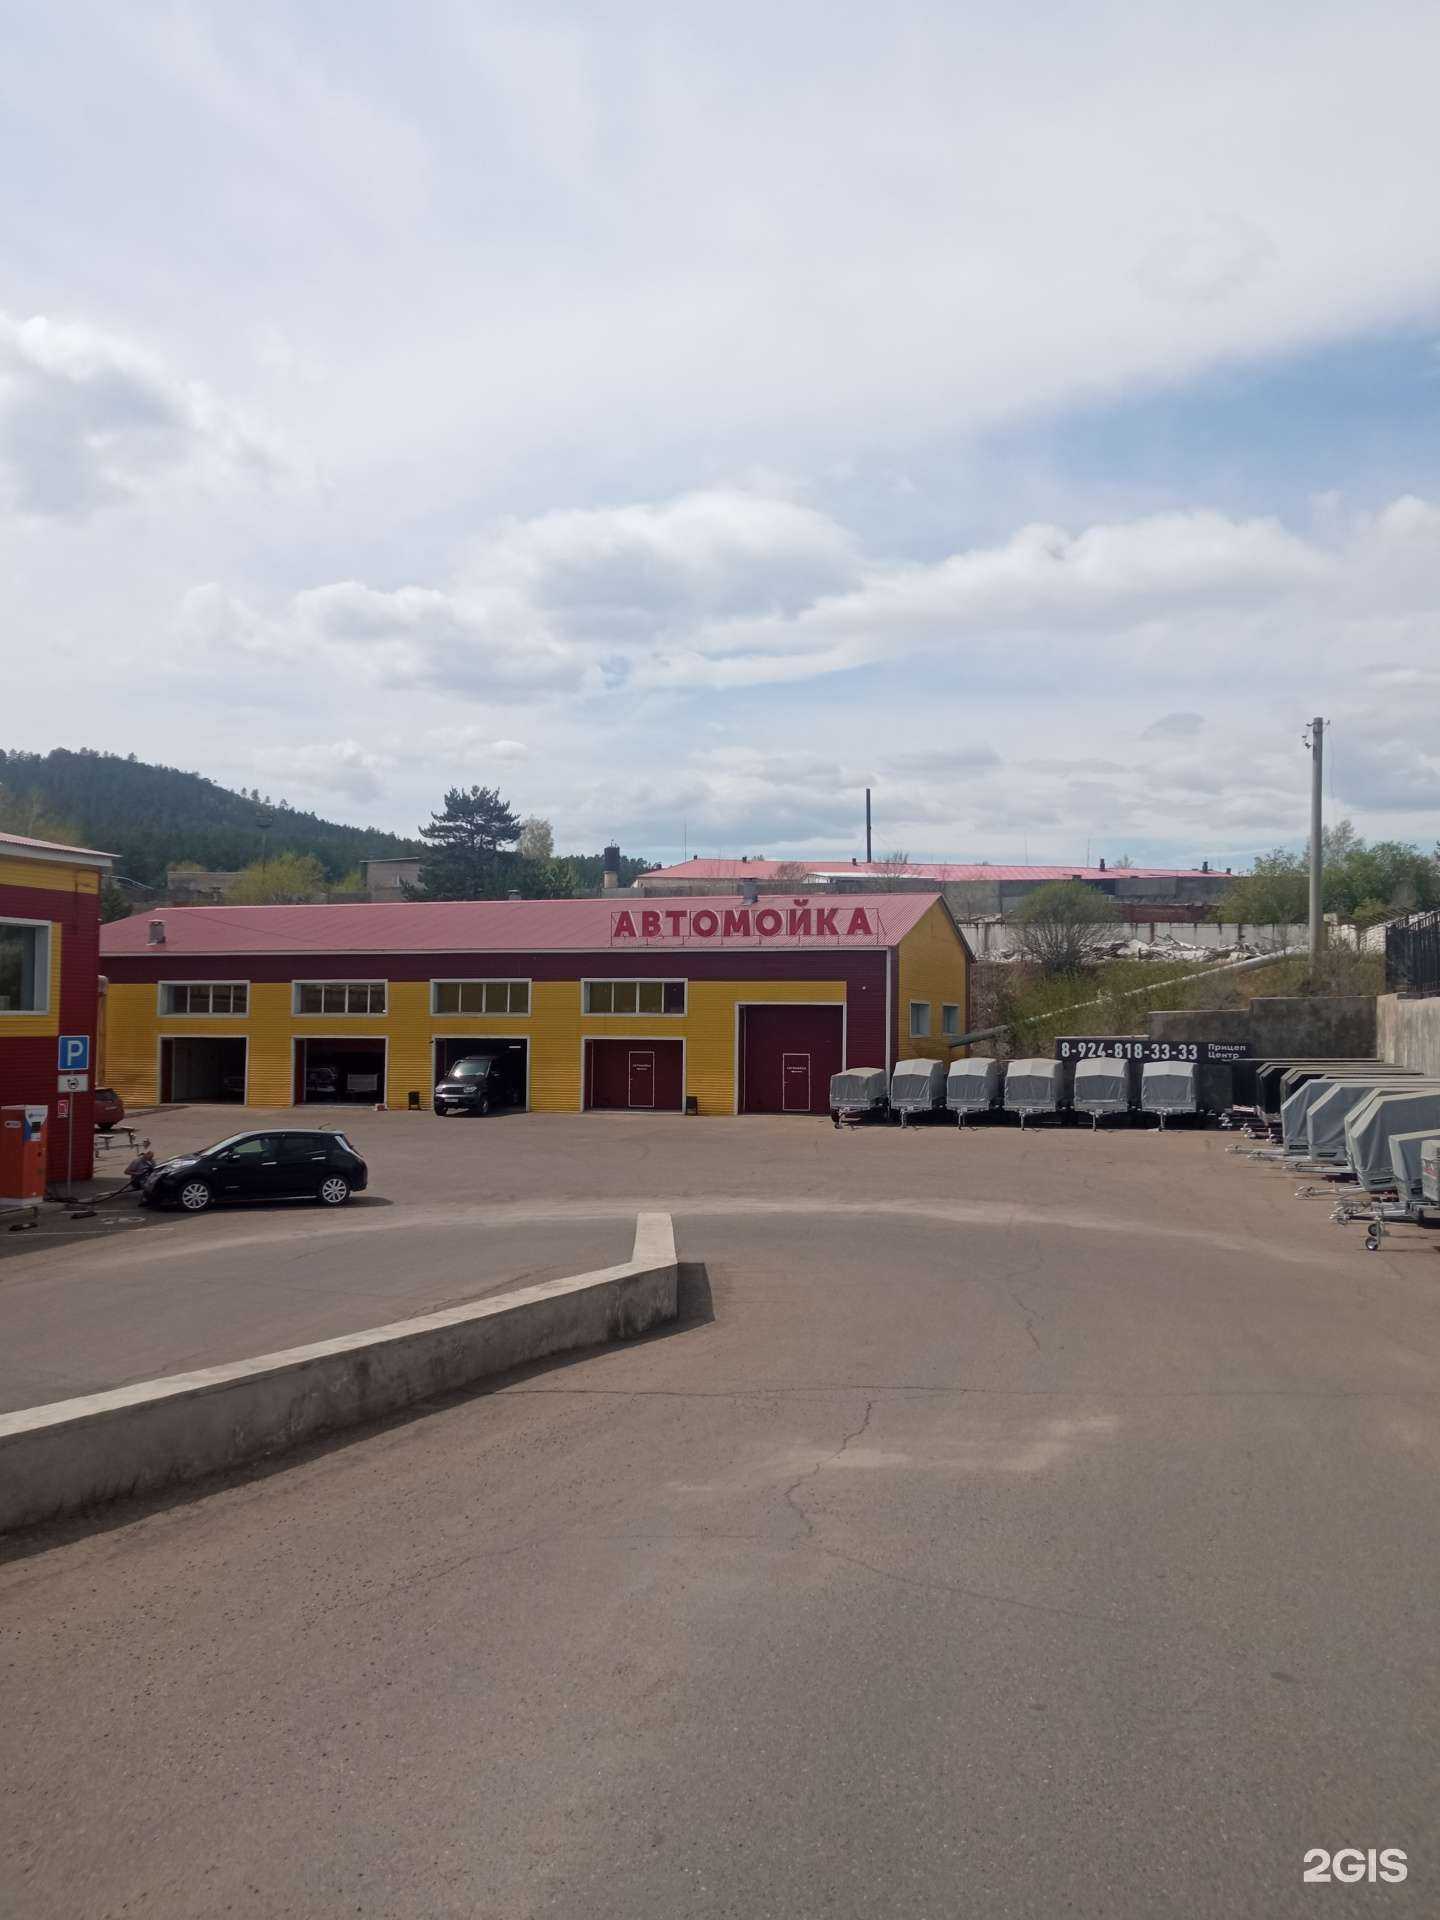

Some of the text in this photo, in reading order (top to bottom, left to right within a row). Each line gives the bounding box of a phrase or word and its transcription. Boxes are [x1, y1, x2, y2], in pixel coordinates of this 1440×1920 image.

[614, 899, 872, 937] АВТОМОЙКА
[67, 1041, 84, 1066] P
[1061, 1042, 1198, 1060] 8-924-818-33-33
[1208, 1043, 1246, 1051] Прицеп
[1208, 1051, 1240, 1060] Центр
